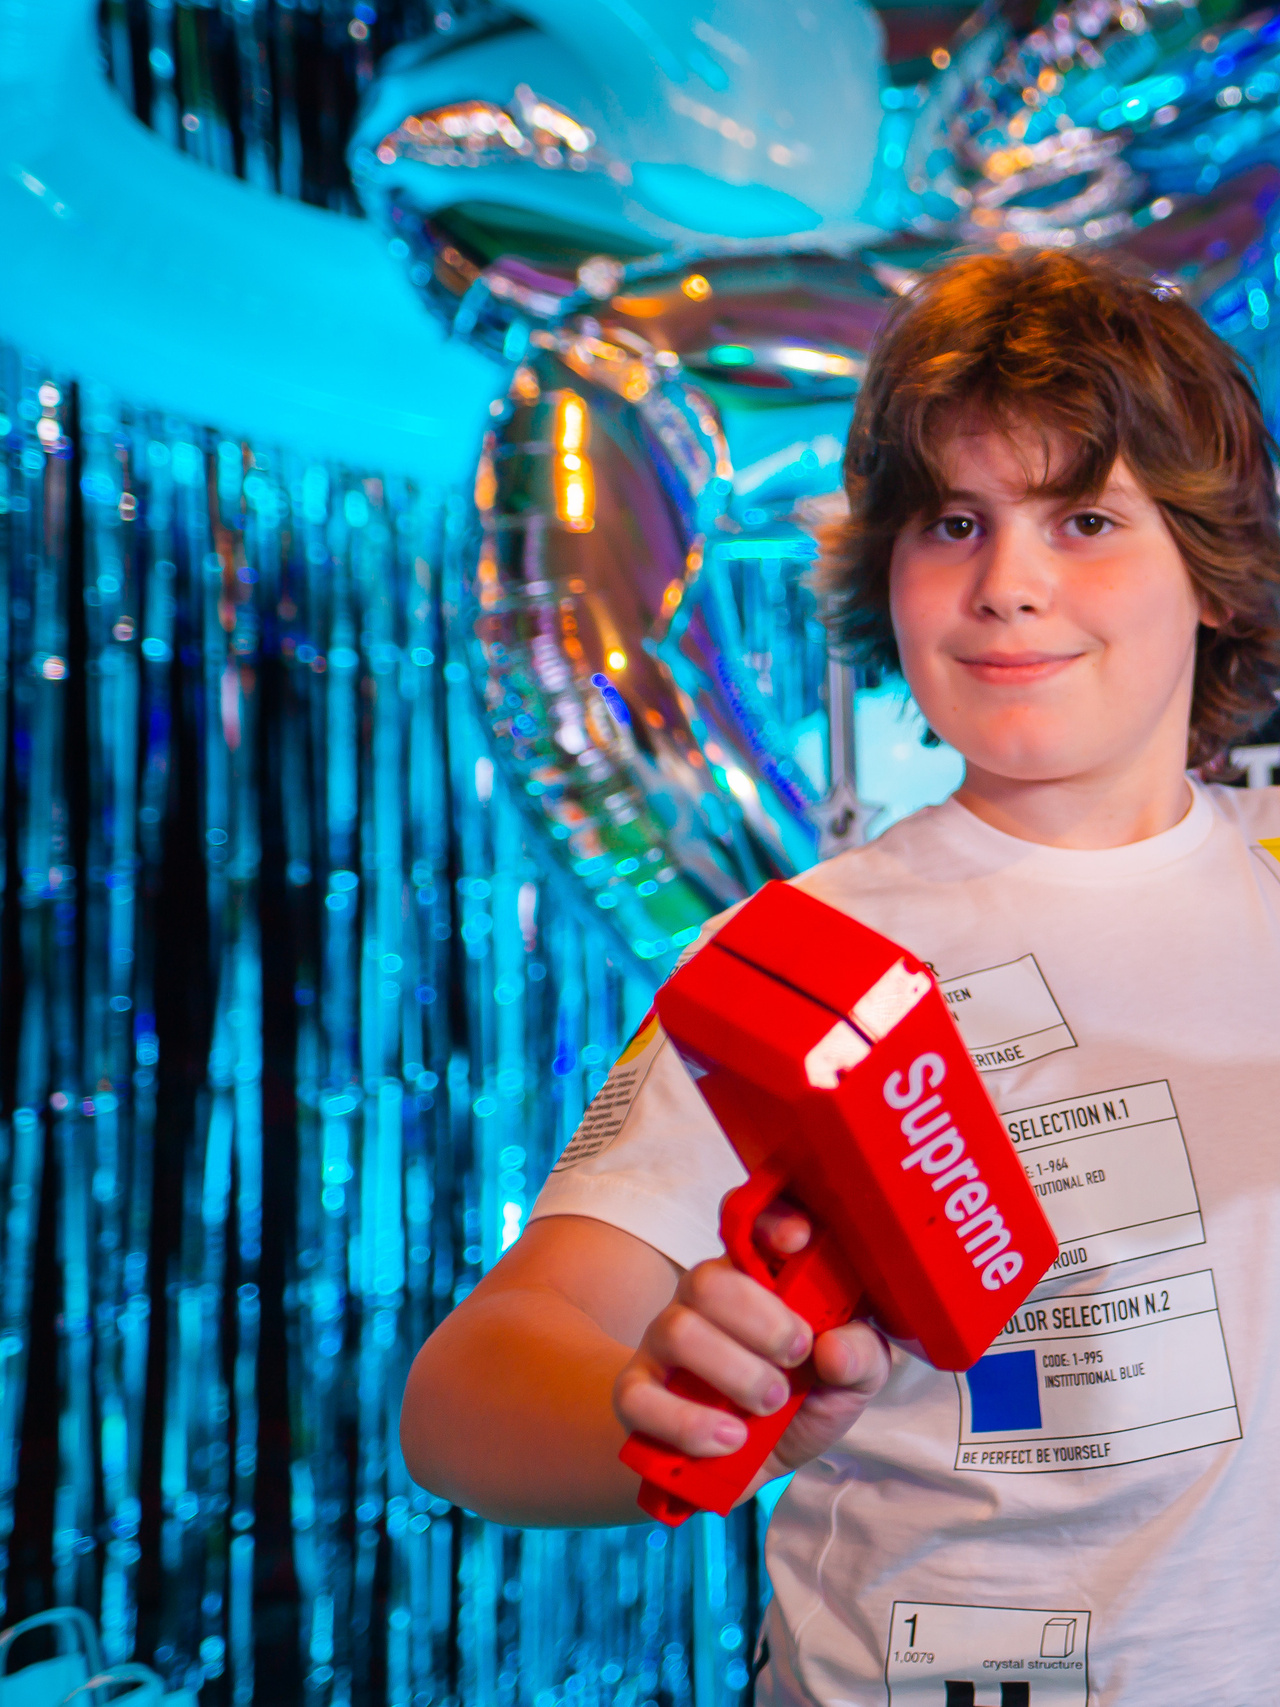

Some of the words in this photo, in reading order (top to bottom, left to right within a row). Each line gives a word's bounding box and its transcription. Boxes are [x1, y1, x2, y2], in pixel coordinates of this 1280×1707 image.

[1008, 1105, 1101, 1143] SELECTION
[1103, 1098, 1129, 1122] N.1
[883, 1052, 1024, 1291] Supreme
[1036, 1157, 1069, 1176] 1-964
[1085, 1169, 1106, 1185] RED
[1048, 1247, 1088, 1270] ROUD
[998, 1310, 1048, 1336] OLOR
[1052, 1296, 1140, 1330] SELECTION
[1145, 1290, 1171, 1315] N.2
[1043, 1353, 1070, 1368] CODE:
[1072, 1350, 1104, 1365] 1-995
[1044, 1369, 1117, 1389] INSTITUTIONAL
[1119, 1362, 1145, 1380] BLUE
[962, 1452, 978, 1464] BE
[1036, 1448, 1051, 1464] BE
[1052, 1442, 1111, 1462] YOURSELF
[904, 1613, 918, 1648] 1
[893, 1651, 935, 1664] 1.0079
[982, 1659, 1024, 1671] crystal
[1027, 1660, 1083, 1670] structure
